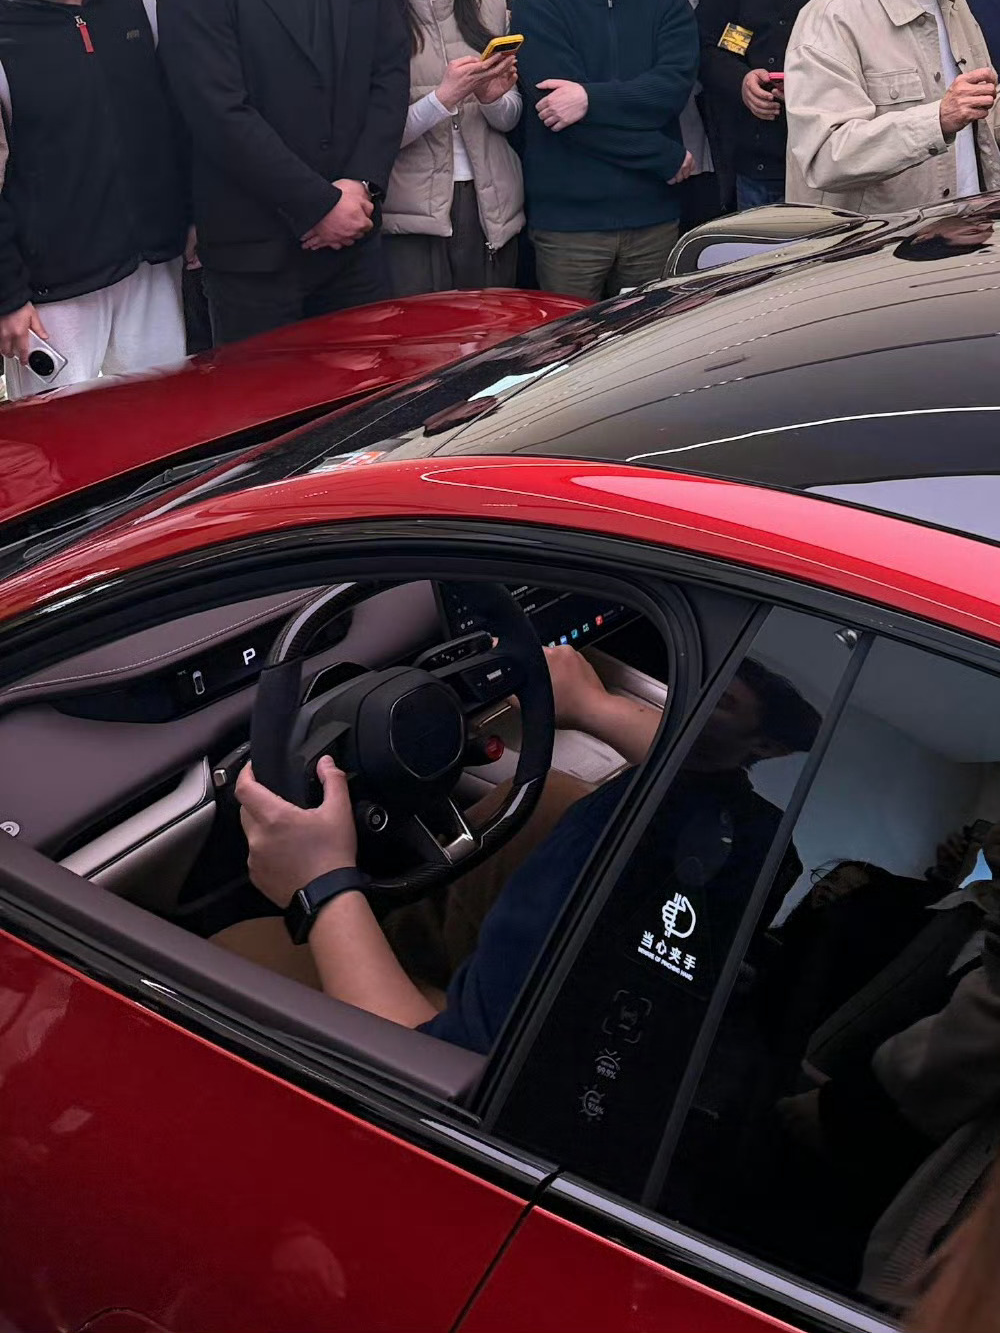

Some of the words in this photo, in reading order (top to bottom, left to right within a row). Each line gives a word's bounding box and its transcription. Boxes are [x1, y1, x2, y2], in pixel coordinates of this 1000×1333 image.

[243, 648, 256, 666] P
[640, 930, 697, 970] 当心夹手
